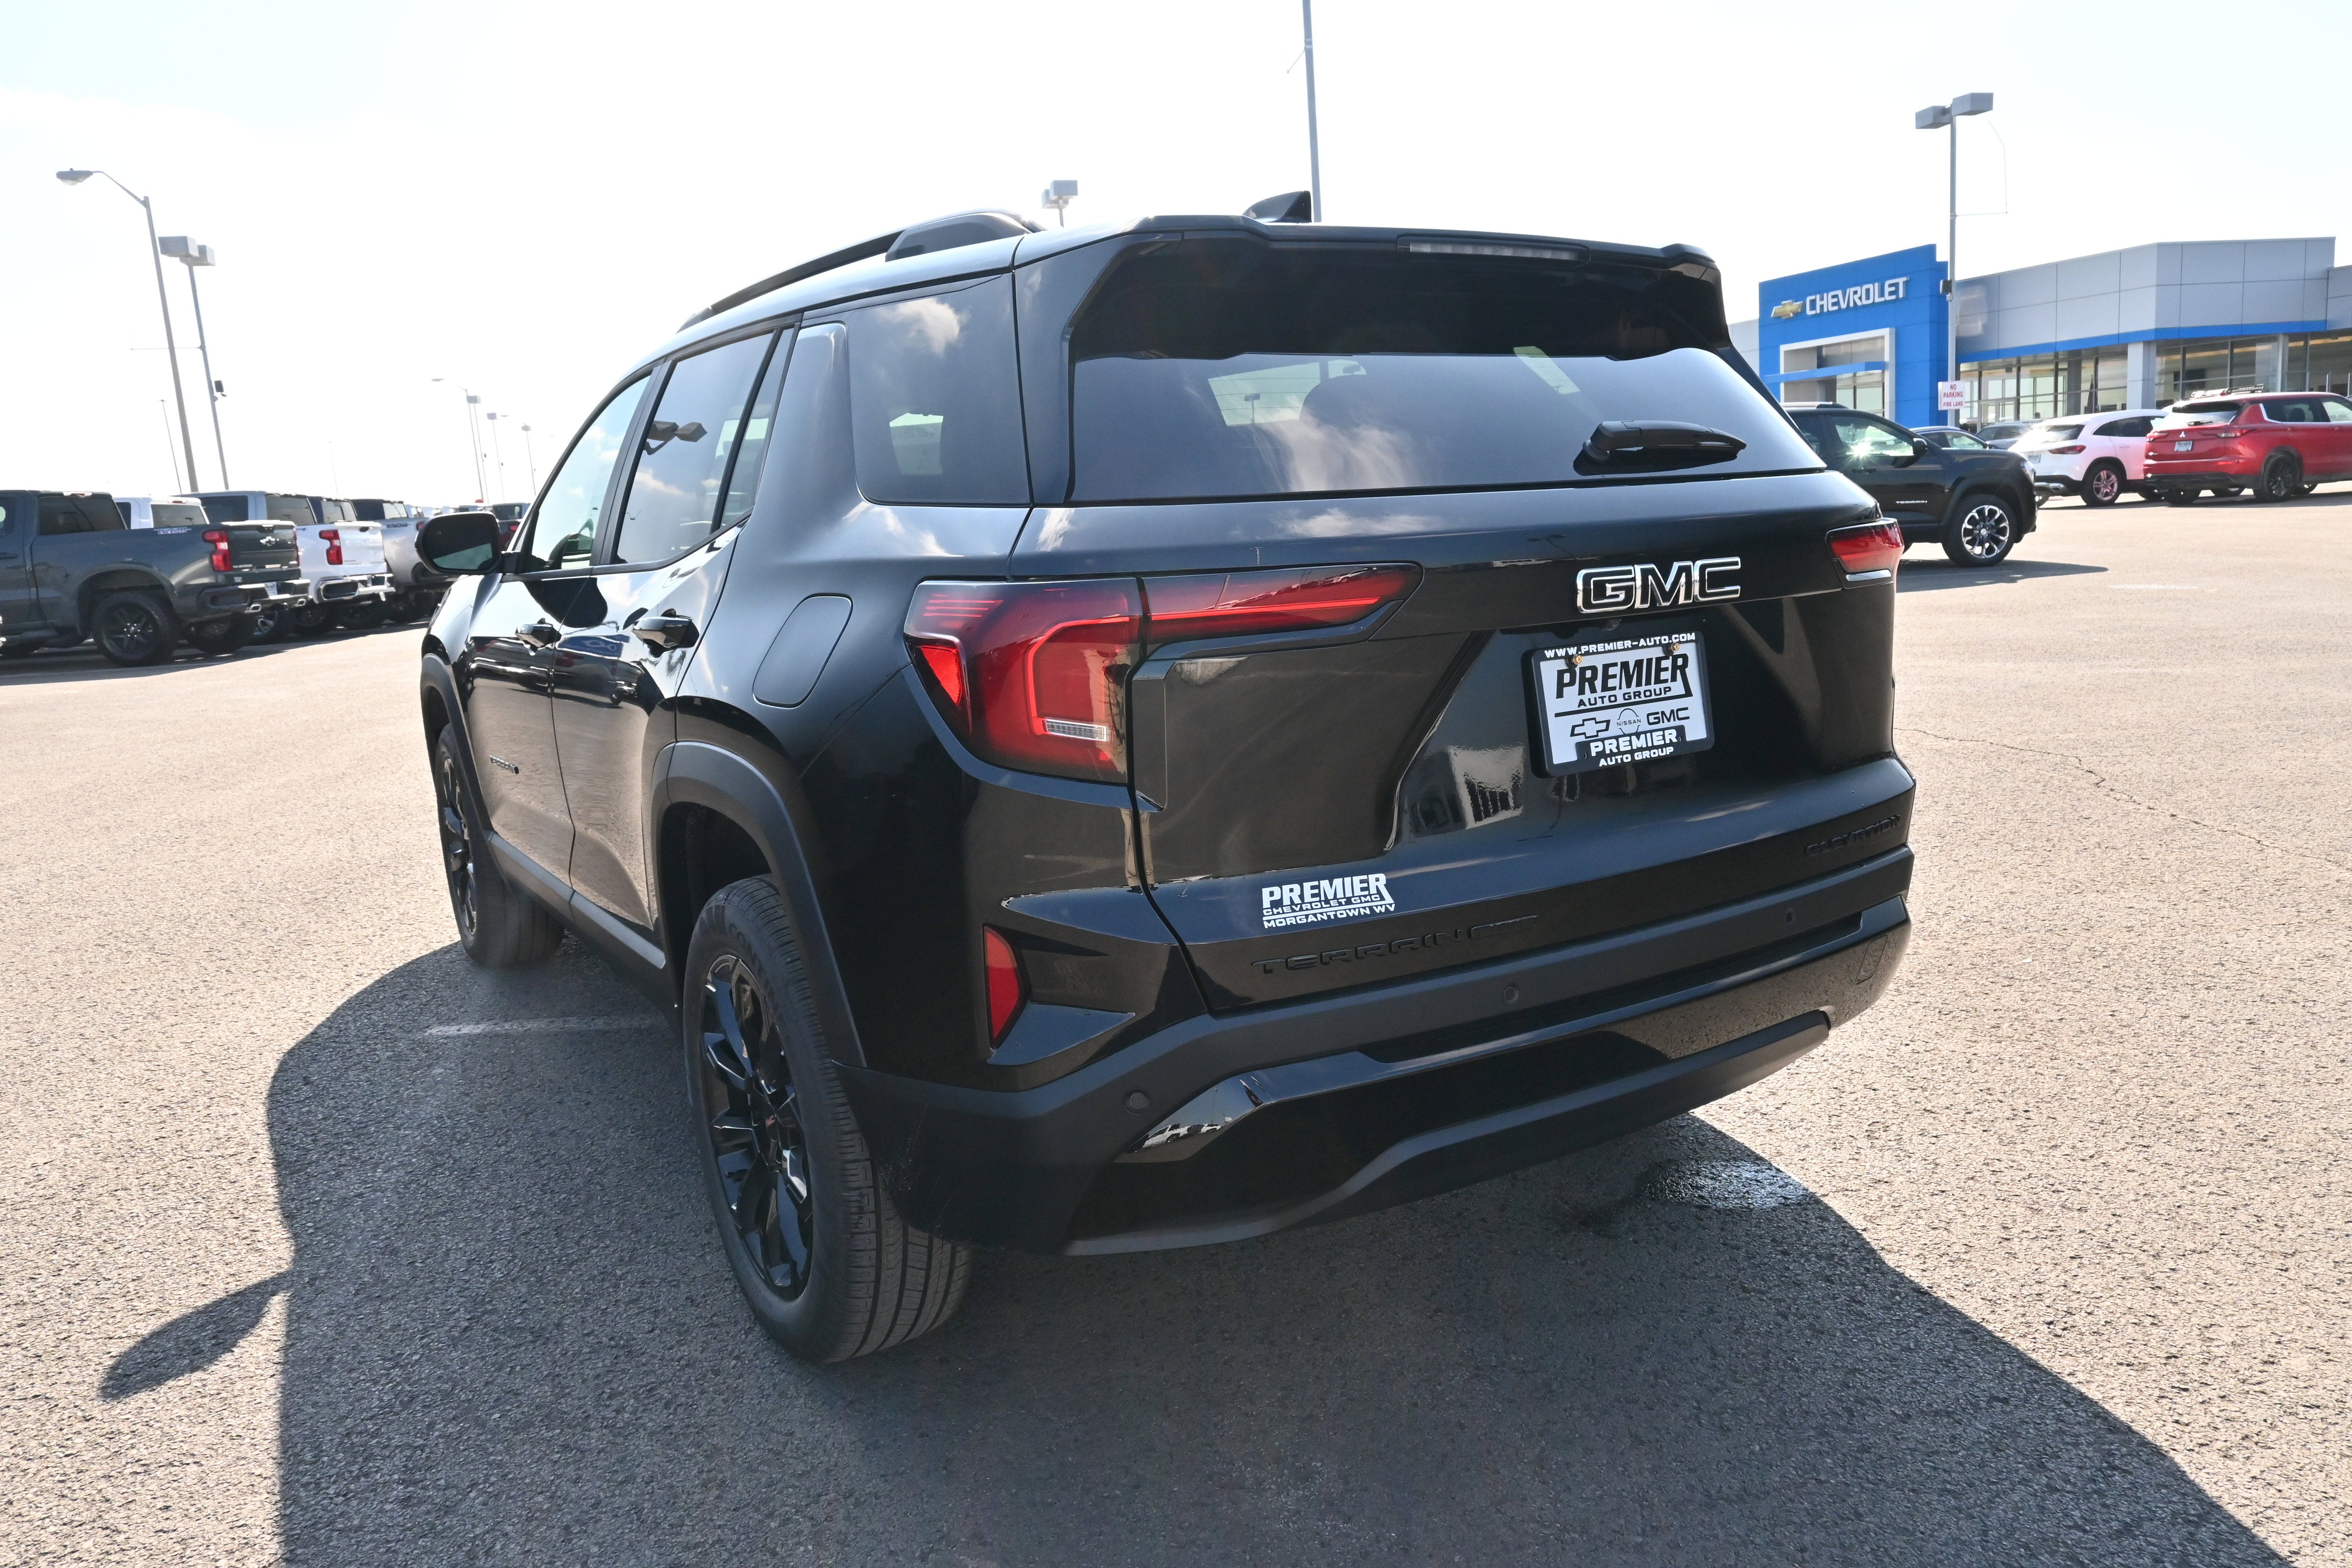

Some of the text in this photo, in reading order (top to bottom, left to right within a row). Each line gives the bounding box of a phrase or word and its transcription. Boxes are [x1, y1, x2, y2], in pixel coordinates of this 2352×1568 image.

[1806, 277, 1909, 315] CHEVROLET
[1576, 556, 1741, 614] GMC
[1544, 632, 1696, 658] WWW.PREMIER-AUTO.COM
[1555, 653, 1693, 700] PREMIER
[1577, 686, 1672, 708] AUTO GROUP
[1616, 707, 1690, 727] NISSAN GMC
[1590, 728, 1678, 757] PREMIER
[1599, 746, 1674, 767] AUTO GROUP
[1261, 873, 1395, 909] PREMIER
[1263, 894, 1381, 916] CHEVROLET GMC
[1264, 904, 1396, 929] MORGANTOWN WV
[1251, 929, 1464, 974] TERRAIN
